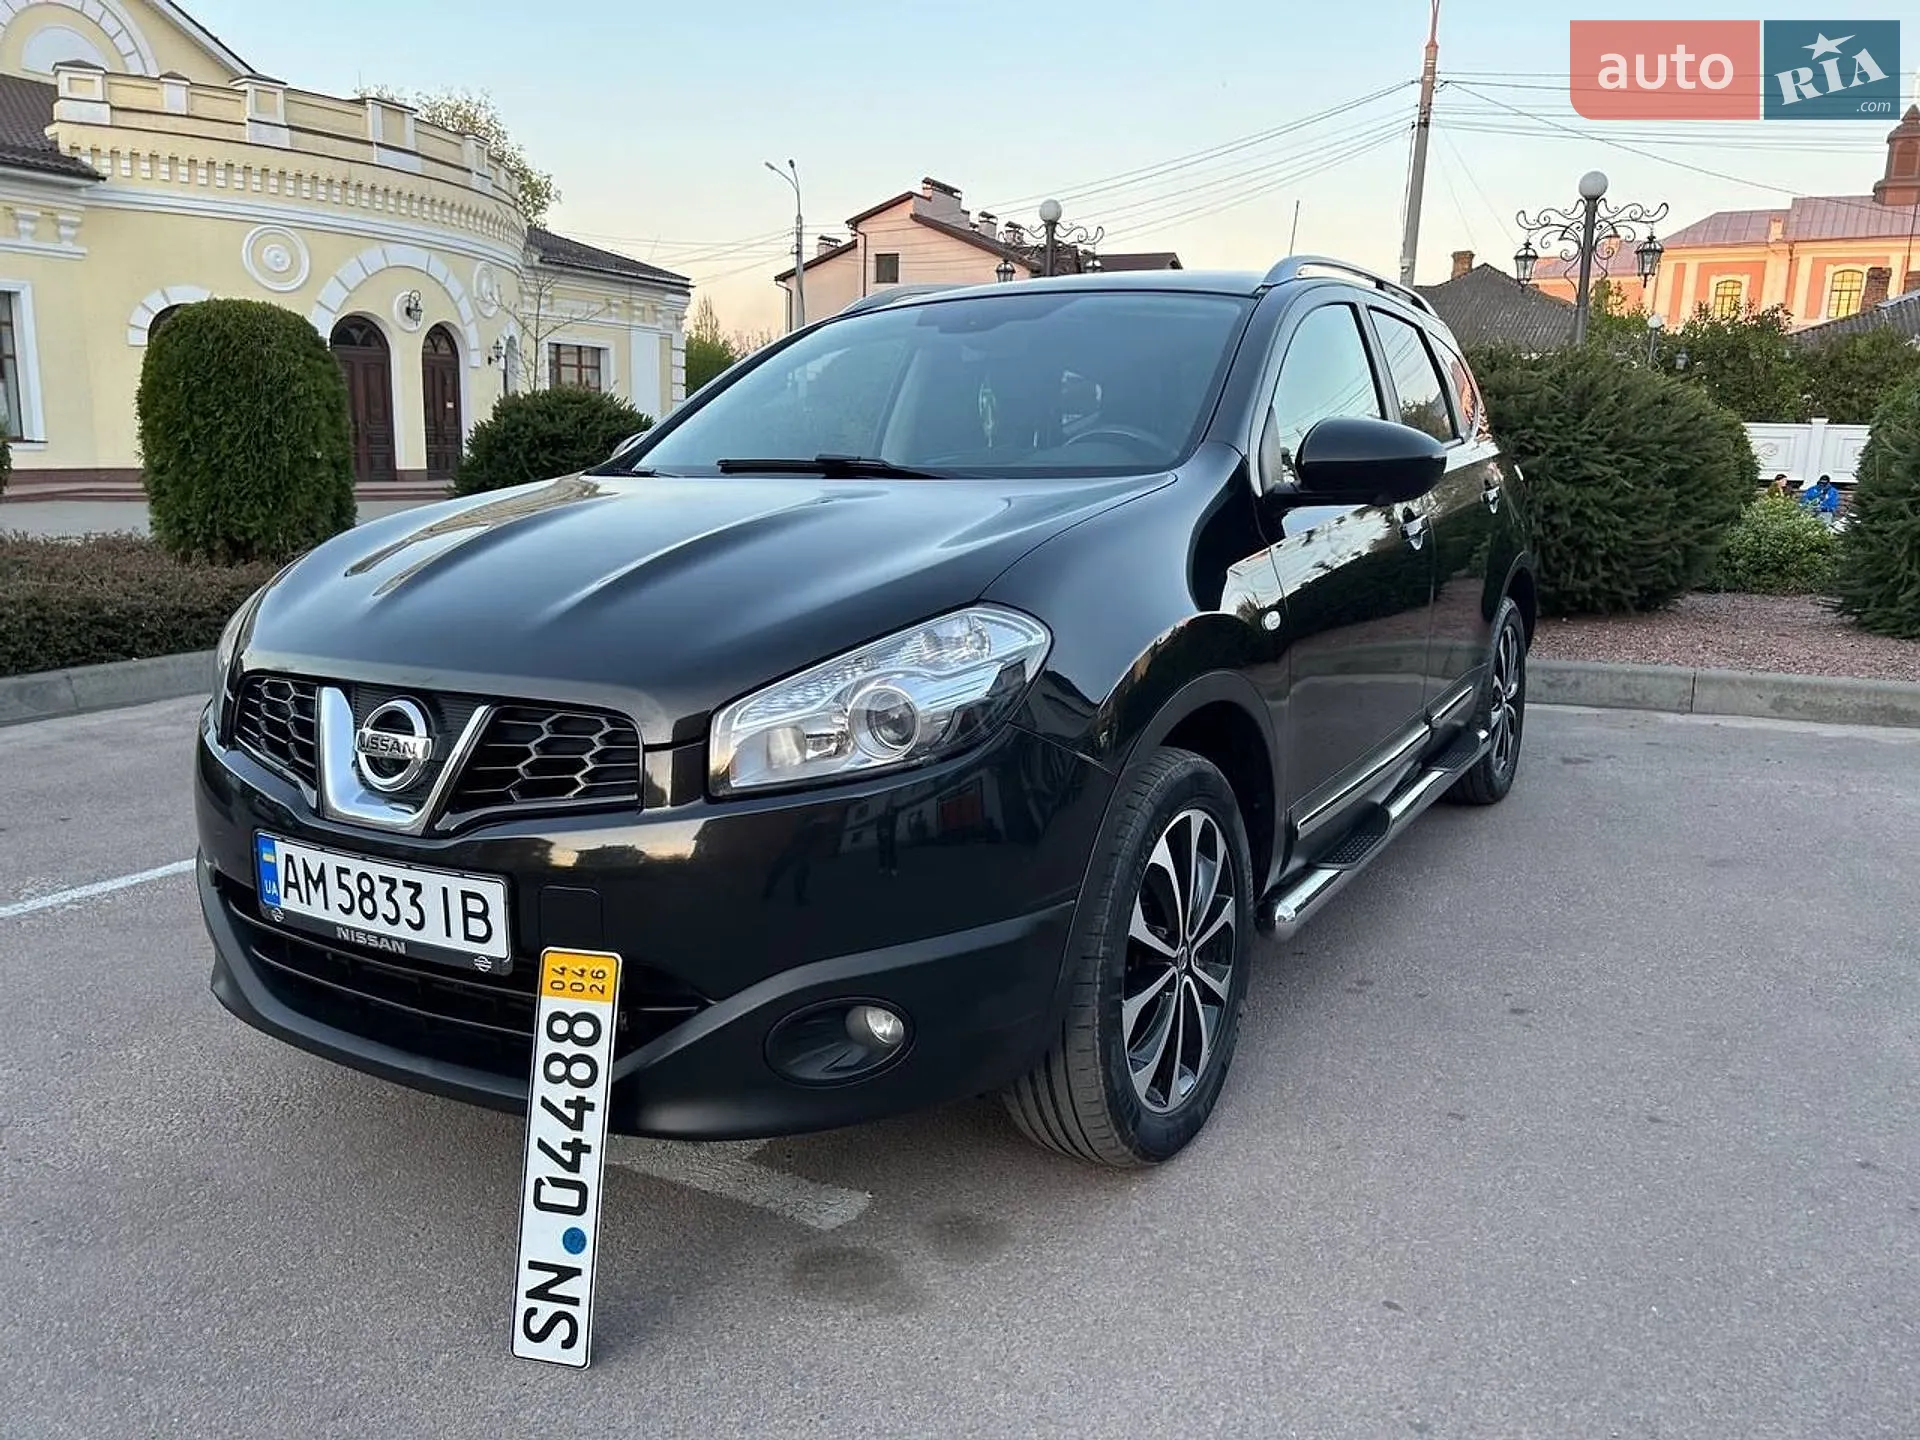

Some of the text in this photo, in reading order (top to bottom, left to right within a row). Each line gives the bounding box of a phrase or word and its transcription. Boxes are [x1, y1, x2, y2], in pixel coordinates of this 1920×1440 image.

[359, 734, 417, 755] NISSAN
[265, 879, 279, 896] UA
[284, 854, 493, 944] AM 5833 IB
[336, 926, 407, 954] NISSAN
[550, 966, 566, 990] 04
[570, 968, 587, 992] 04
[589, 969, 607, 995] 26
[523, 1010, 602, 1350] SN 04488
